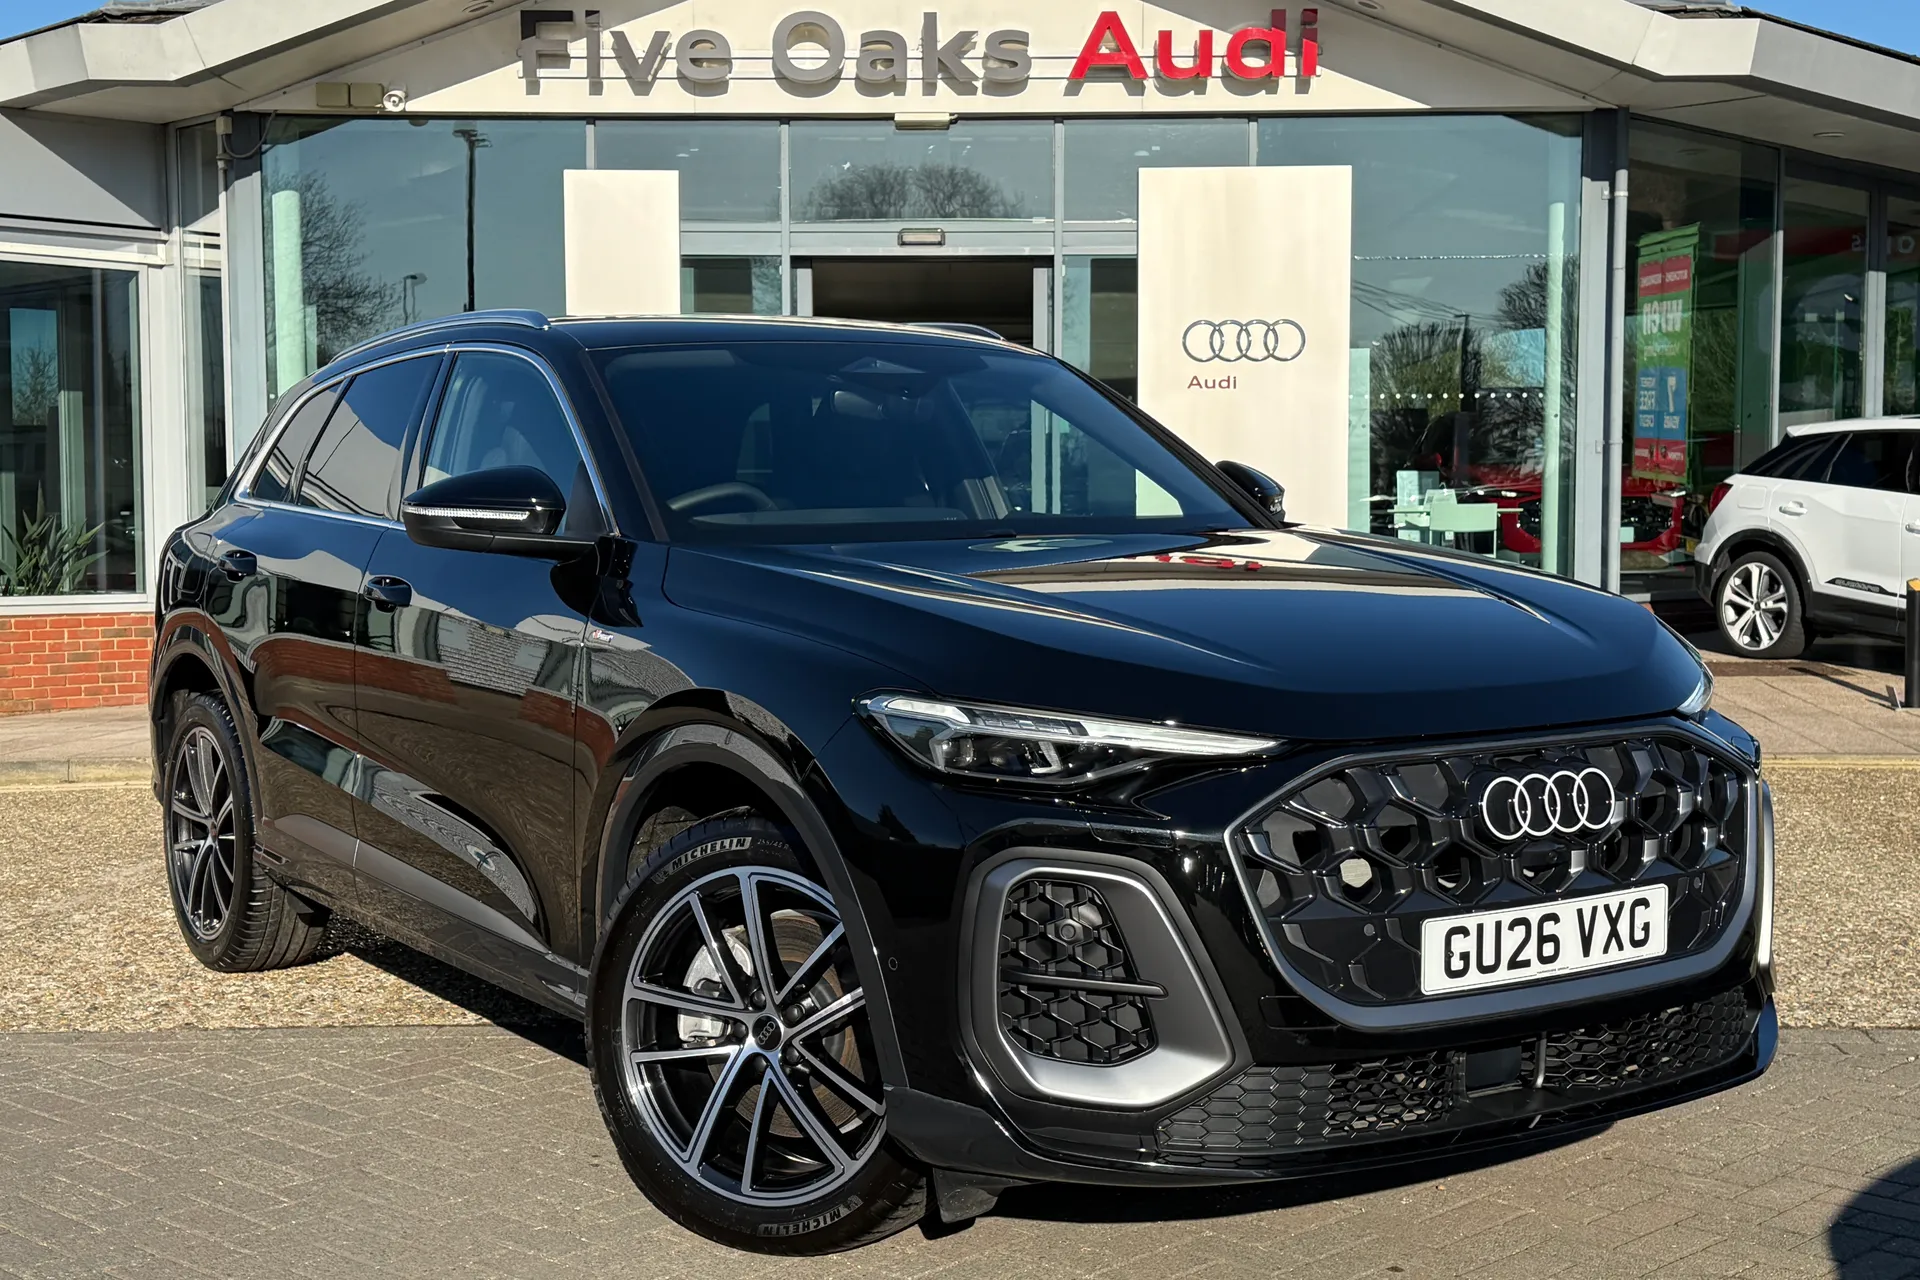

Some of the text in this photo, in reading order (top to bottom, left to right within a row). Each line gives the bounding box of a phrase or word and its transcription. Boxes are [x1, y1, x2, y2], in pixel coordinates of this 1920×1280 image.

[520, 8, 1318, 84] Five Oaks Audi
[1187, 375, 1237, 389] Audi
[671, 837, 747, 870] MICHELIN
[1444, 897, 1651, 980] GU26 VXG
[761, 1208, 842, 1236] MICHELIN
